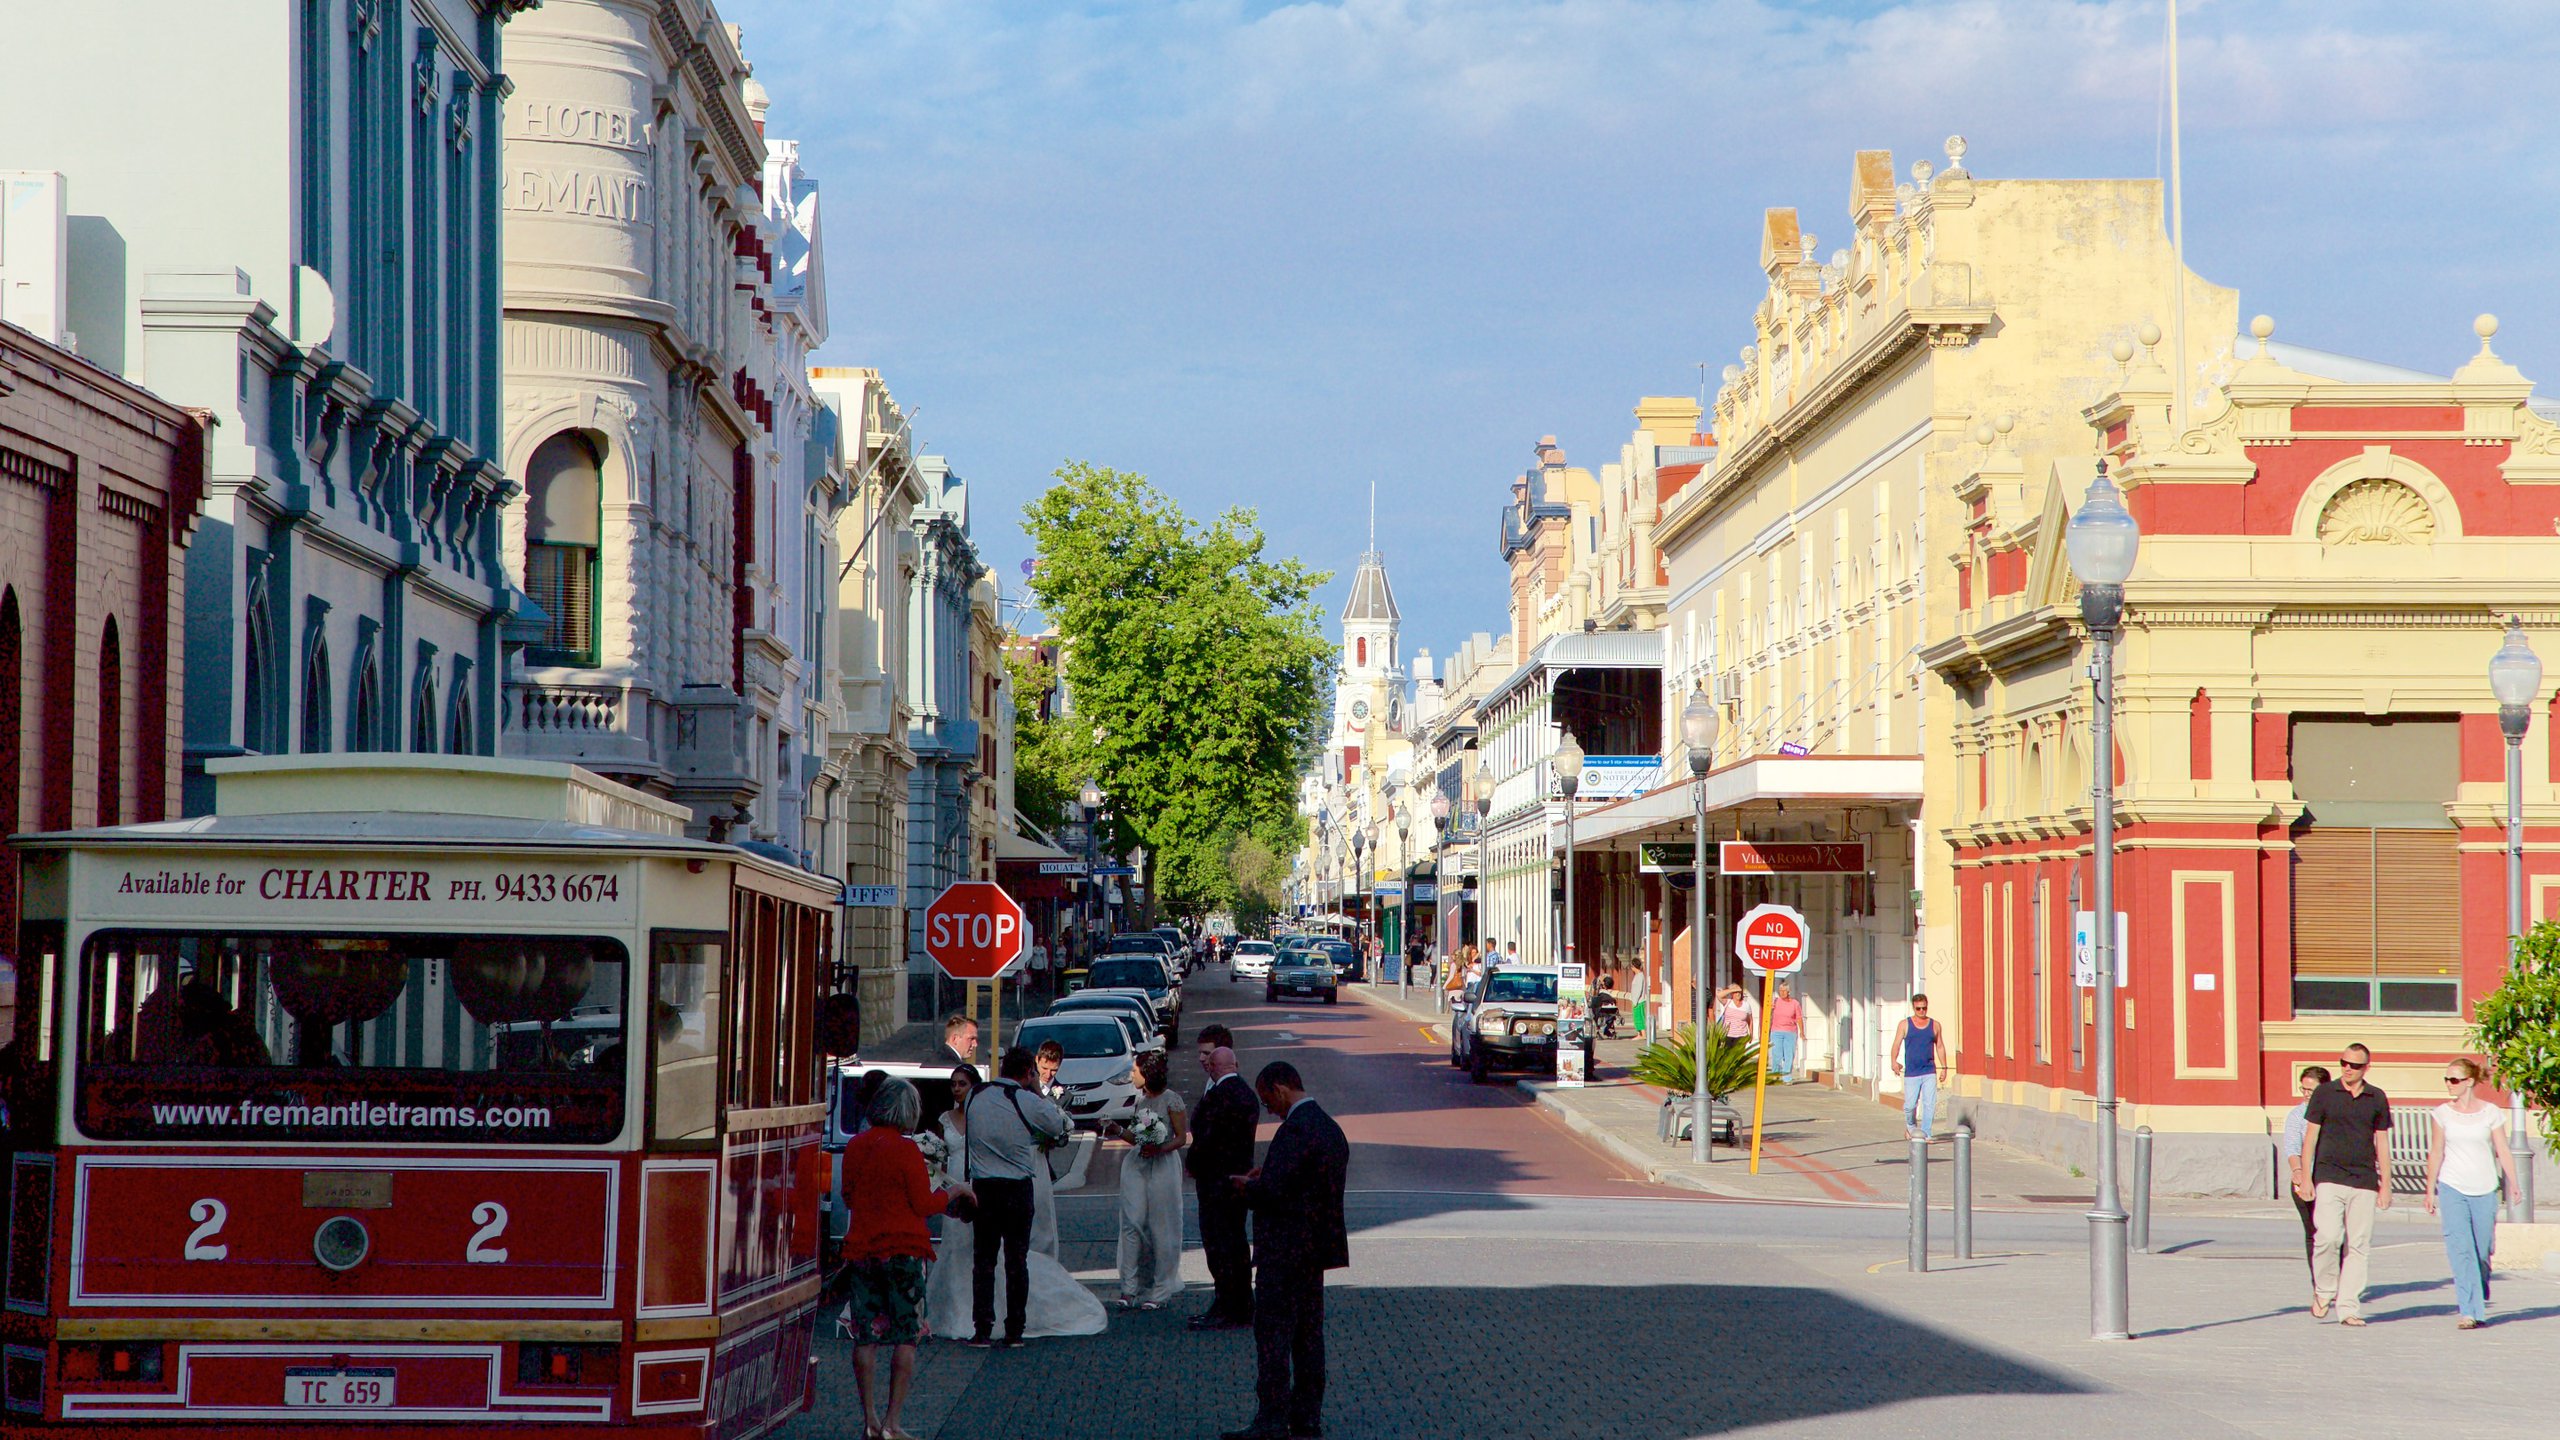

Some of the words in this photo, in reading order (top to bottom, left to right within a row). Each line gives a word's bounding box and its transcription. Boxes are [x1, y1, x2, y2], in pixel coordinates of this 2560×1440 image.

[521, 103, 640, 147] HOTEL
[1041, 863, 1074, 872] MOUAT
[118, 870, 210, 895] Available
[215, 872, 246, 895] for
[259, 868, 431, 901] CHARTER
[448, 880, 486, 901] PH.
[495, 873, 556, 902] 9433
[562, 873, 619, 902] 6674
[850, 887, 883, 903] IFF
[883, 887, 896, 896] ST
[931, 912, 1016, 949] STOP
[1766, 922, 1784, 934] NO
[1753, 948, 1794, 961] ENTRY
[152, 1099, 551, 1128] www.fremantletrams.com
[184, 1197, 228, 1261] 2
[466, 1200, 508, 1264] 2
[301, 1380, 328, 1404] TC
[343, 1380, 381, 1404] 659
